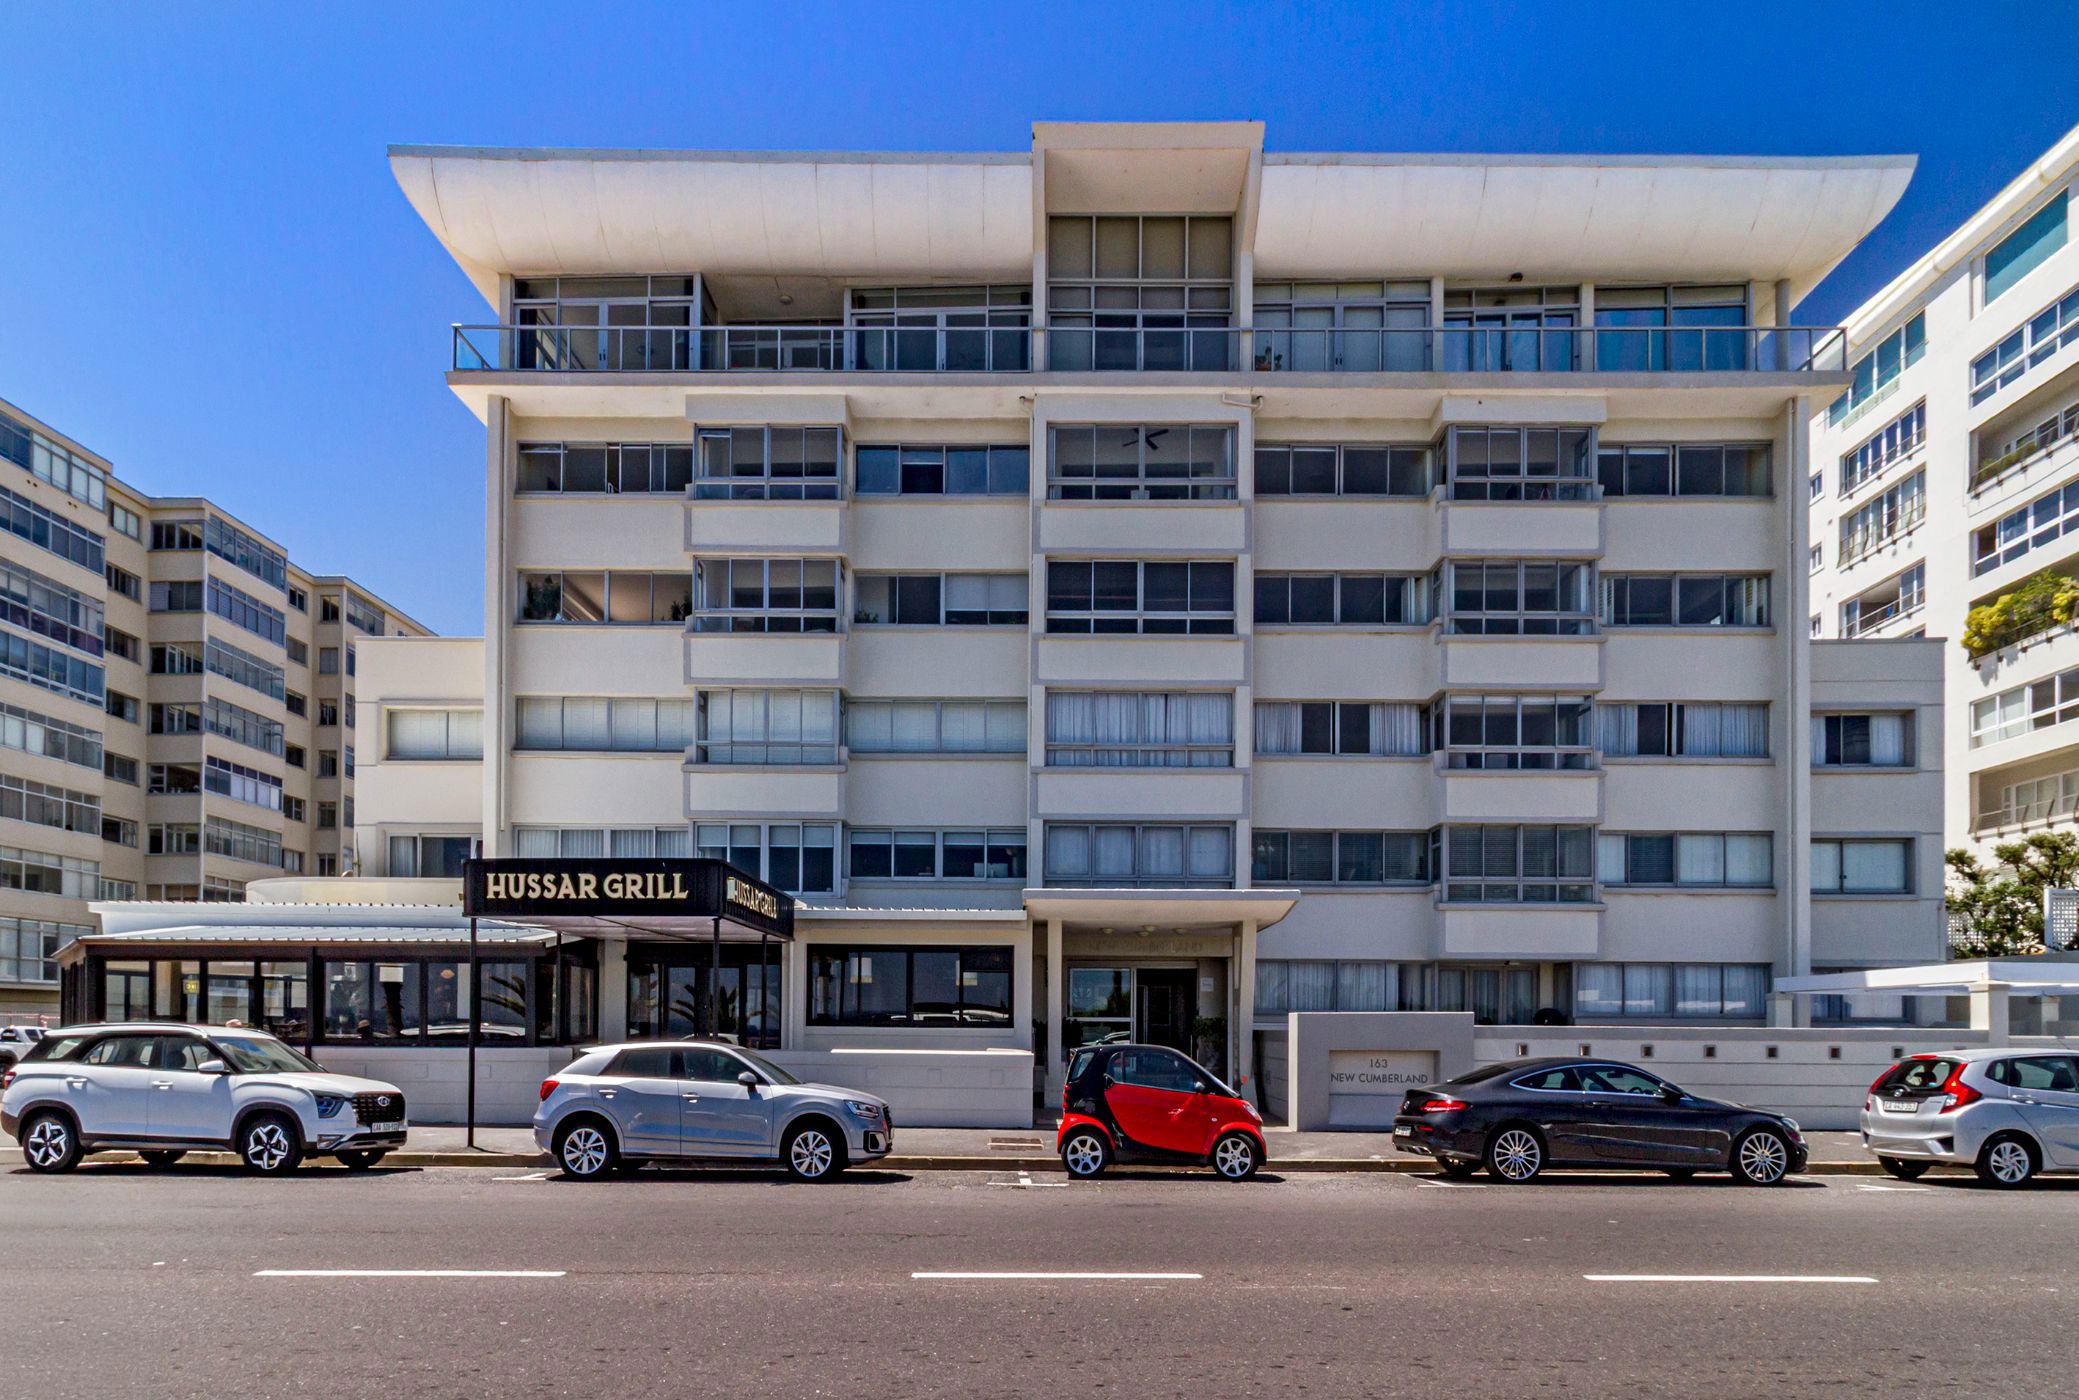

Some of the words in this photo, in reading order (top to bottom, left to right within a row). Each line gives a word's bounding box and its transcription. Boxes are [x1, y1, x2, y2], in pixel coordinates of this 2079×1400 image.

[485, 872, 599, 899] HUSSAR
[603, 872, 689, 900] GRILL
[730, 878, 760, 912] HUSSAR
[758, 892, 777, 919] GRILL
[1370, 1058, 1388, 1069] 163
[1330, 1073, 1355, 1082] NEW
[1358, 1073, 1429, 1084] CUMBERLAND
